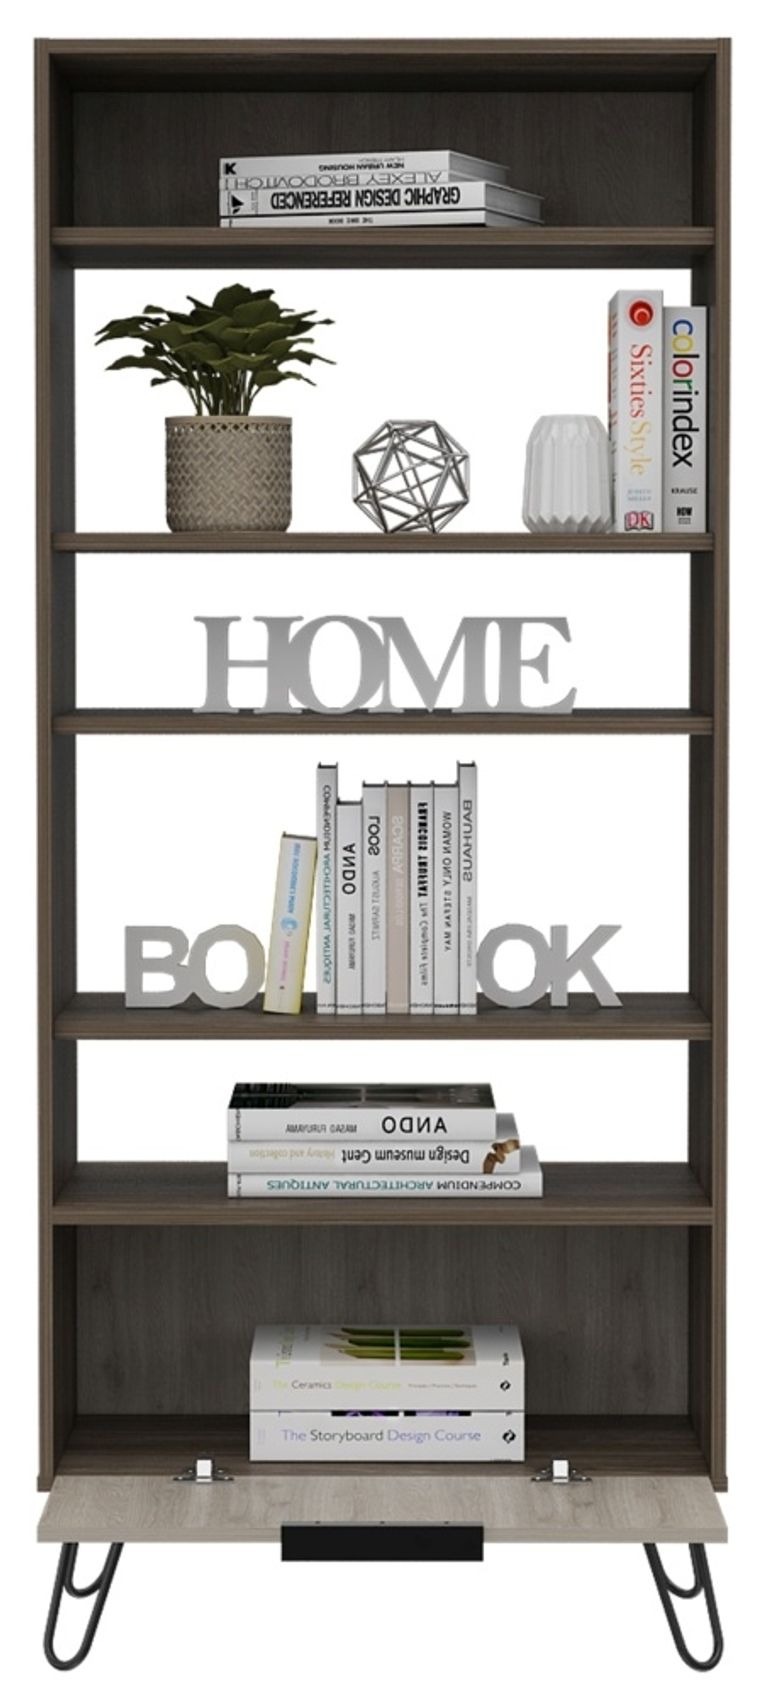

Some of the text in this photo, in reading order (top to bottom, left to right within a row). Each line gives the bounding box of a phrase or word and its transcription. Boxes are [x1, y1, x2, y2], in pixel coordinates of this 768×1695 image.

[318, 164, 355, 172] HOUSING
[235, 171, 442, 190] ALEXEY BRODOVITCH
[270, 190, 350, 210] REFERENCED
[355, 188, 401, 207] DESIGN
[404, 186, 461, 206] GRAPHIC
[672, 319, 700, 468] colorindex
[623, 344, 653, 475] Sixties Style
[671, 487, 698, 495] KRAUSE
[627, 511, 651, 529] DK
[193, 615, 577, 714] HOME
[125, 924, 265, 1009] BO
[476, 923, 623, 1009] OK
[249, 1148, 288, 1159] collection
[289, 1148, 304, 1160] and
[342, 1145, 470, 1164] Design museum Gent
[267, 1179, 521, 1190] COMPENDIUM ARCHITECTURAL ANTIQUES
[291, 1379, 332, 1389] Ceramics
[282, 1429, 306, 1441] The
[310, 1429, 384, 1444] Storyboard
[388, 1429, 431, 1444] Design
[434, 1429, 481, 1441] Course
